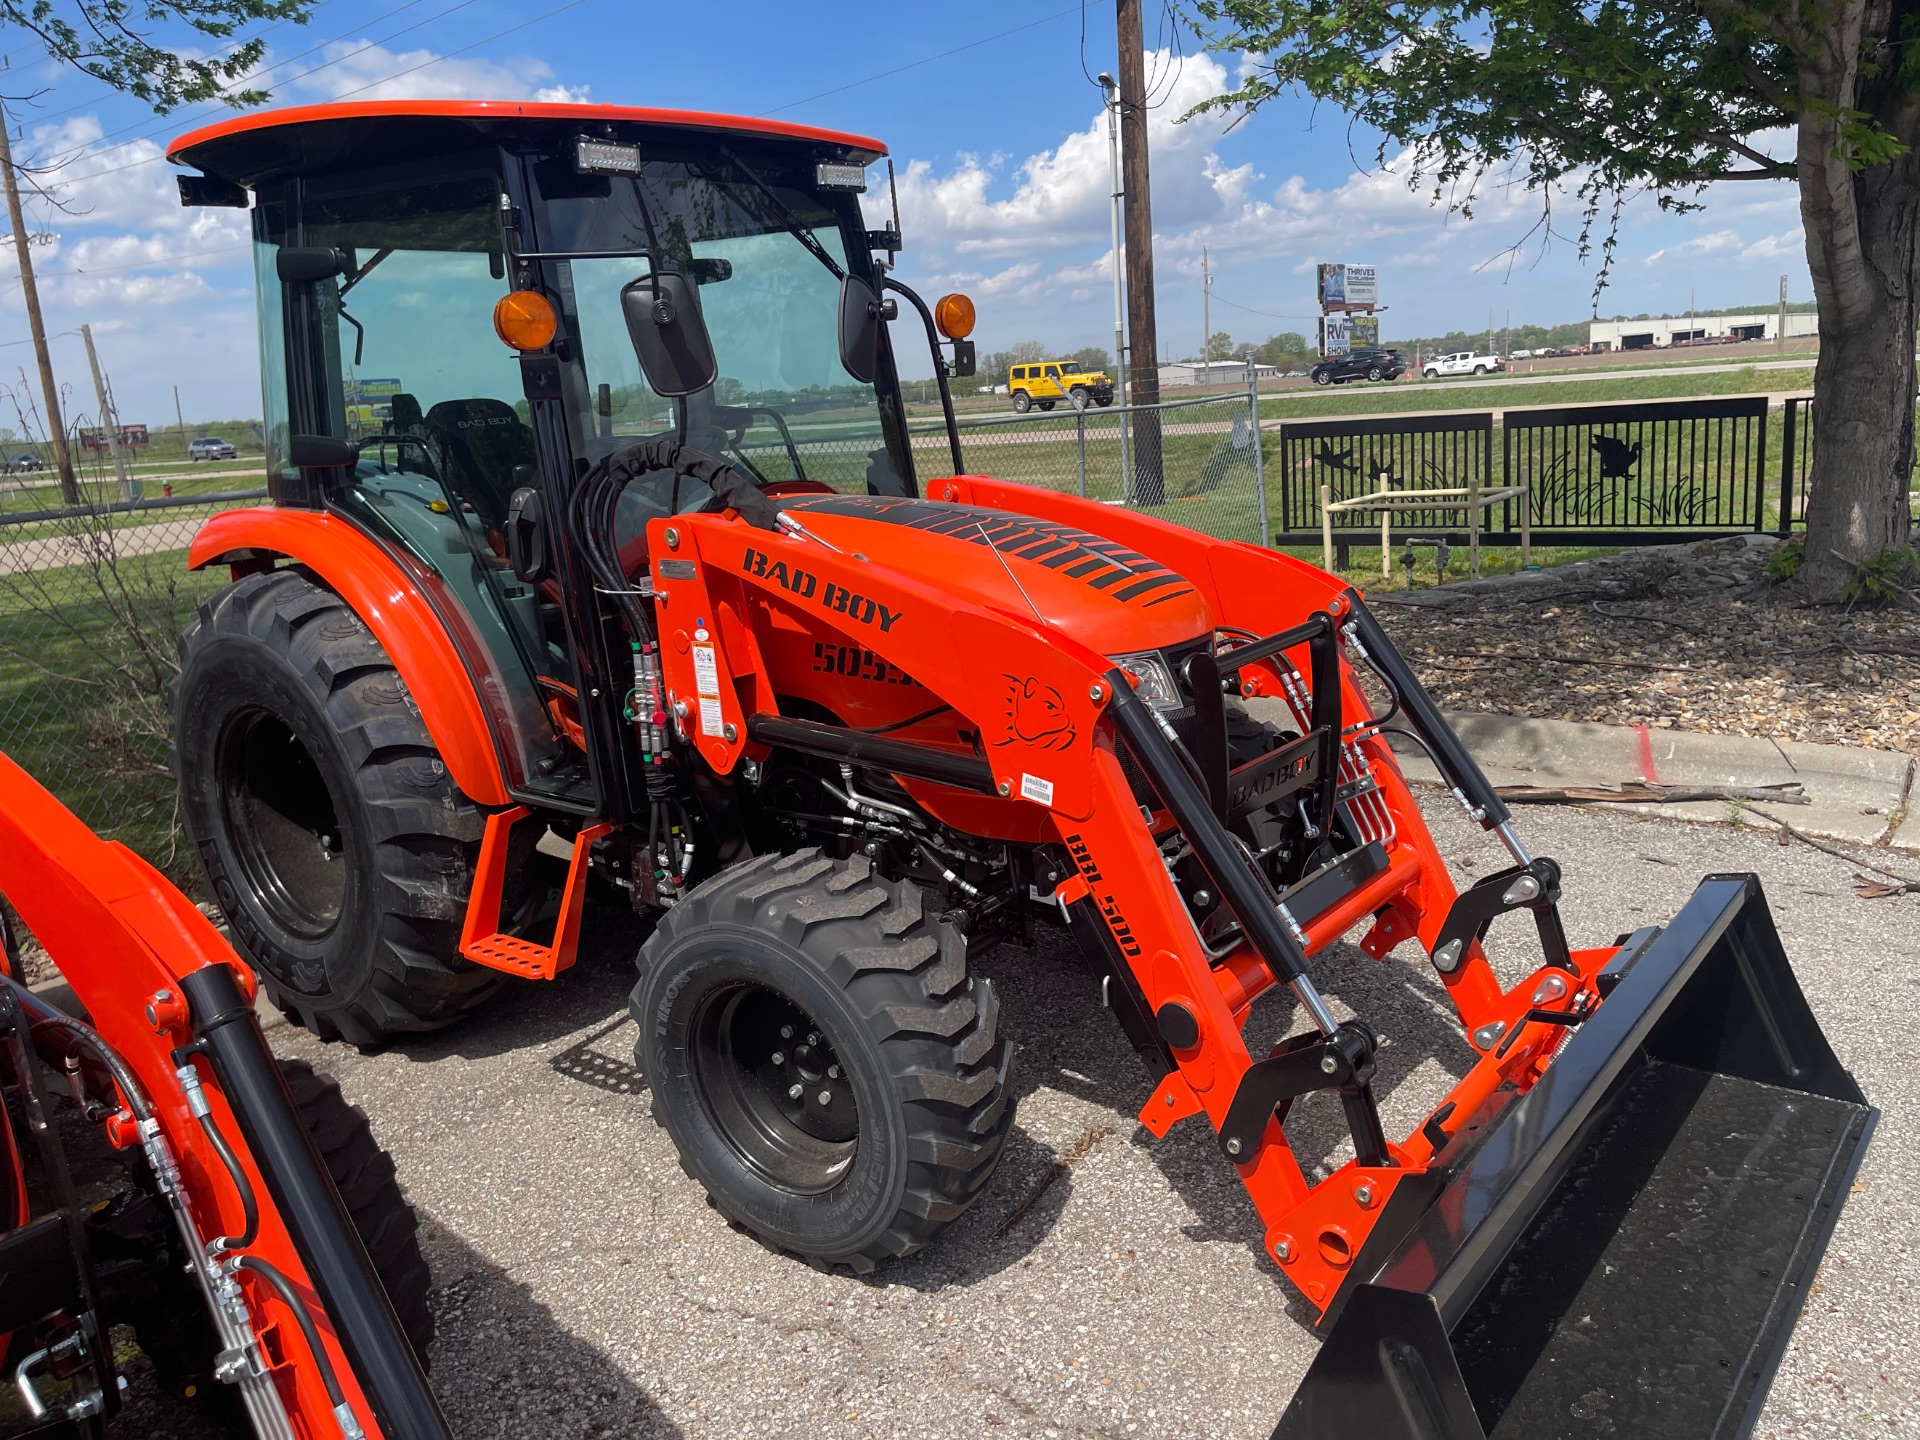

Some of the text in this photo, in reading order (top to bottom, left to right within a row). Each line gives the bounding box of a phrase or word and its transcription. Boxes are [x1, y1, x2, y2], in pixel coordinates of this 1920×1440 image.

[1347, 268, 1375, 276] THRIVES
[1327, 324, 1342, 339] RV
[1327, 346, 1349, 355] SHOW
[457, 416, 511, 428] BAD BOY
[742, 547, 903, 633] BAD BOY
[199, 841, 284, 979] TIRON
[1098, 895, 1142, 957] 500
[654, 971, 691, 1037] TIRON
